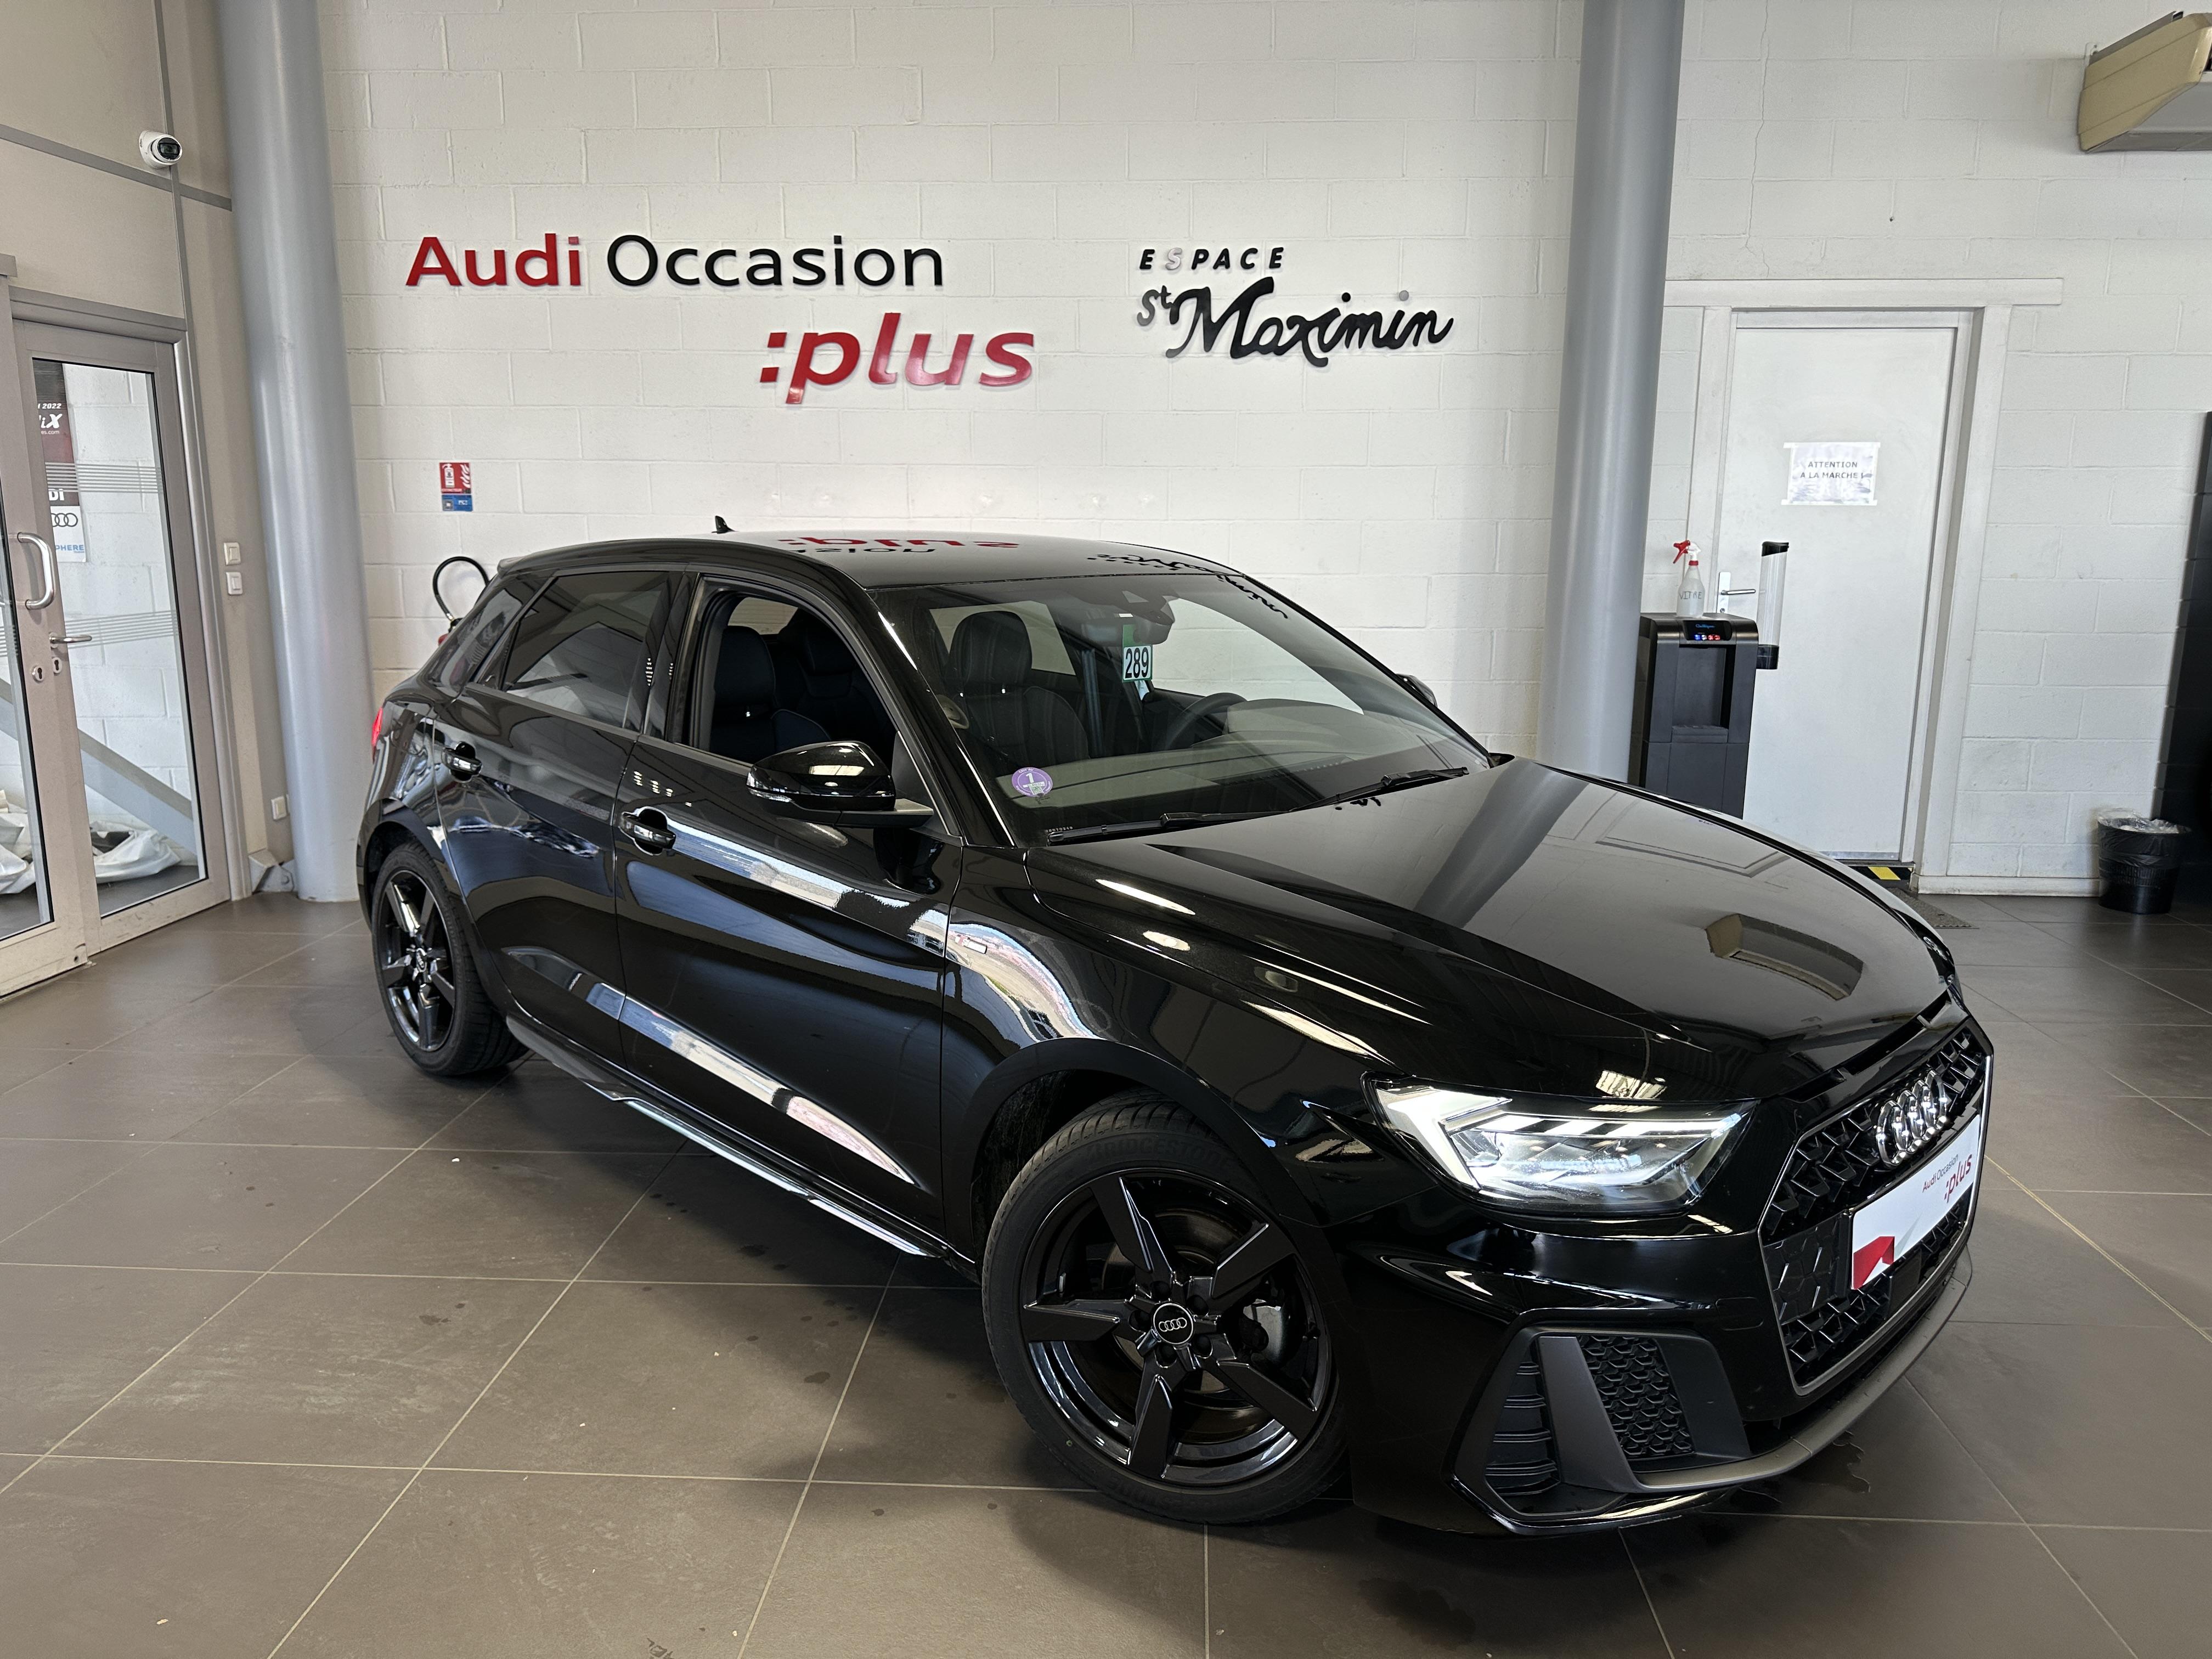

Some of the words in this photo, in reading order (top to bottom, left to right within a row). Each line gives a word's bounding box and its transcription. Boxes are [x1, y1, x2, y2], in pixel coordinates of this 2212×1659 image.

[405, 233, 581, 286] Audi
[607, 234, 943, 286] Occasion
[1139, 247, 1284, 270] ESPACE
[1137, 285, 1172, 326] St
[1165, 276, 1454, 367] Maximin
[760, 312, 1034, 404] :plus
[1125, 647, 1149, 679] 289
[1025, 772, 1035, 784] 1
[1922, 1172, 1937, 1193] Audi
[1937, 1154, 1959, 1181] Occasion
[1944, 1154, 1972, 1204] :plus
